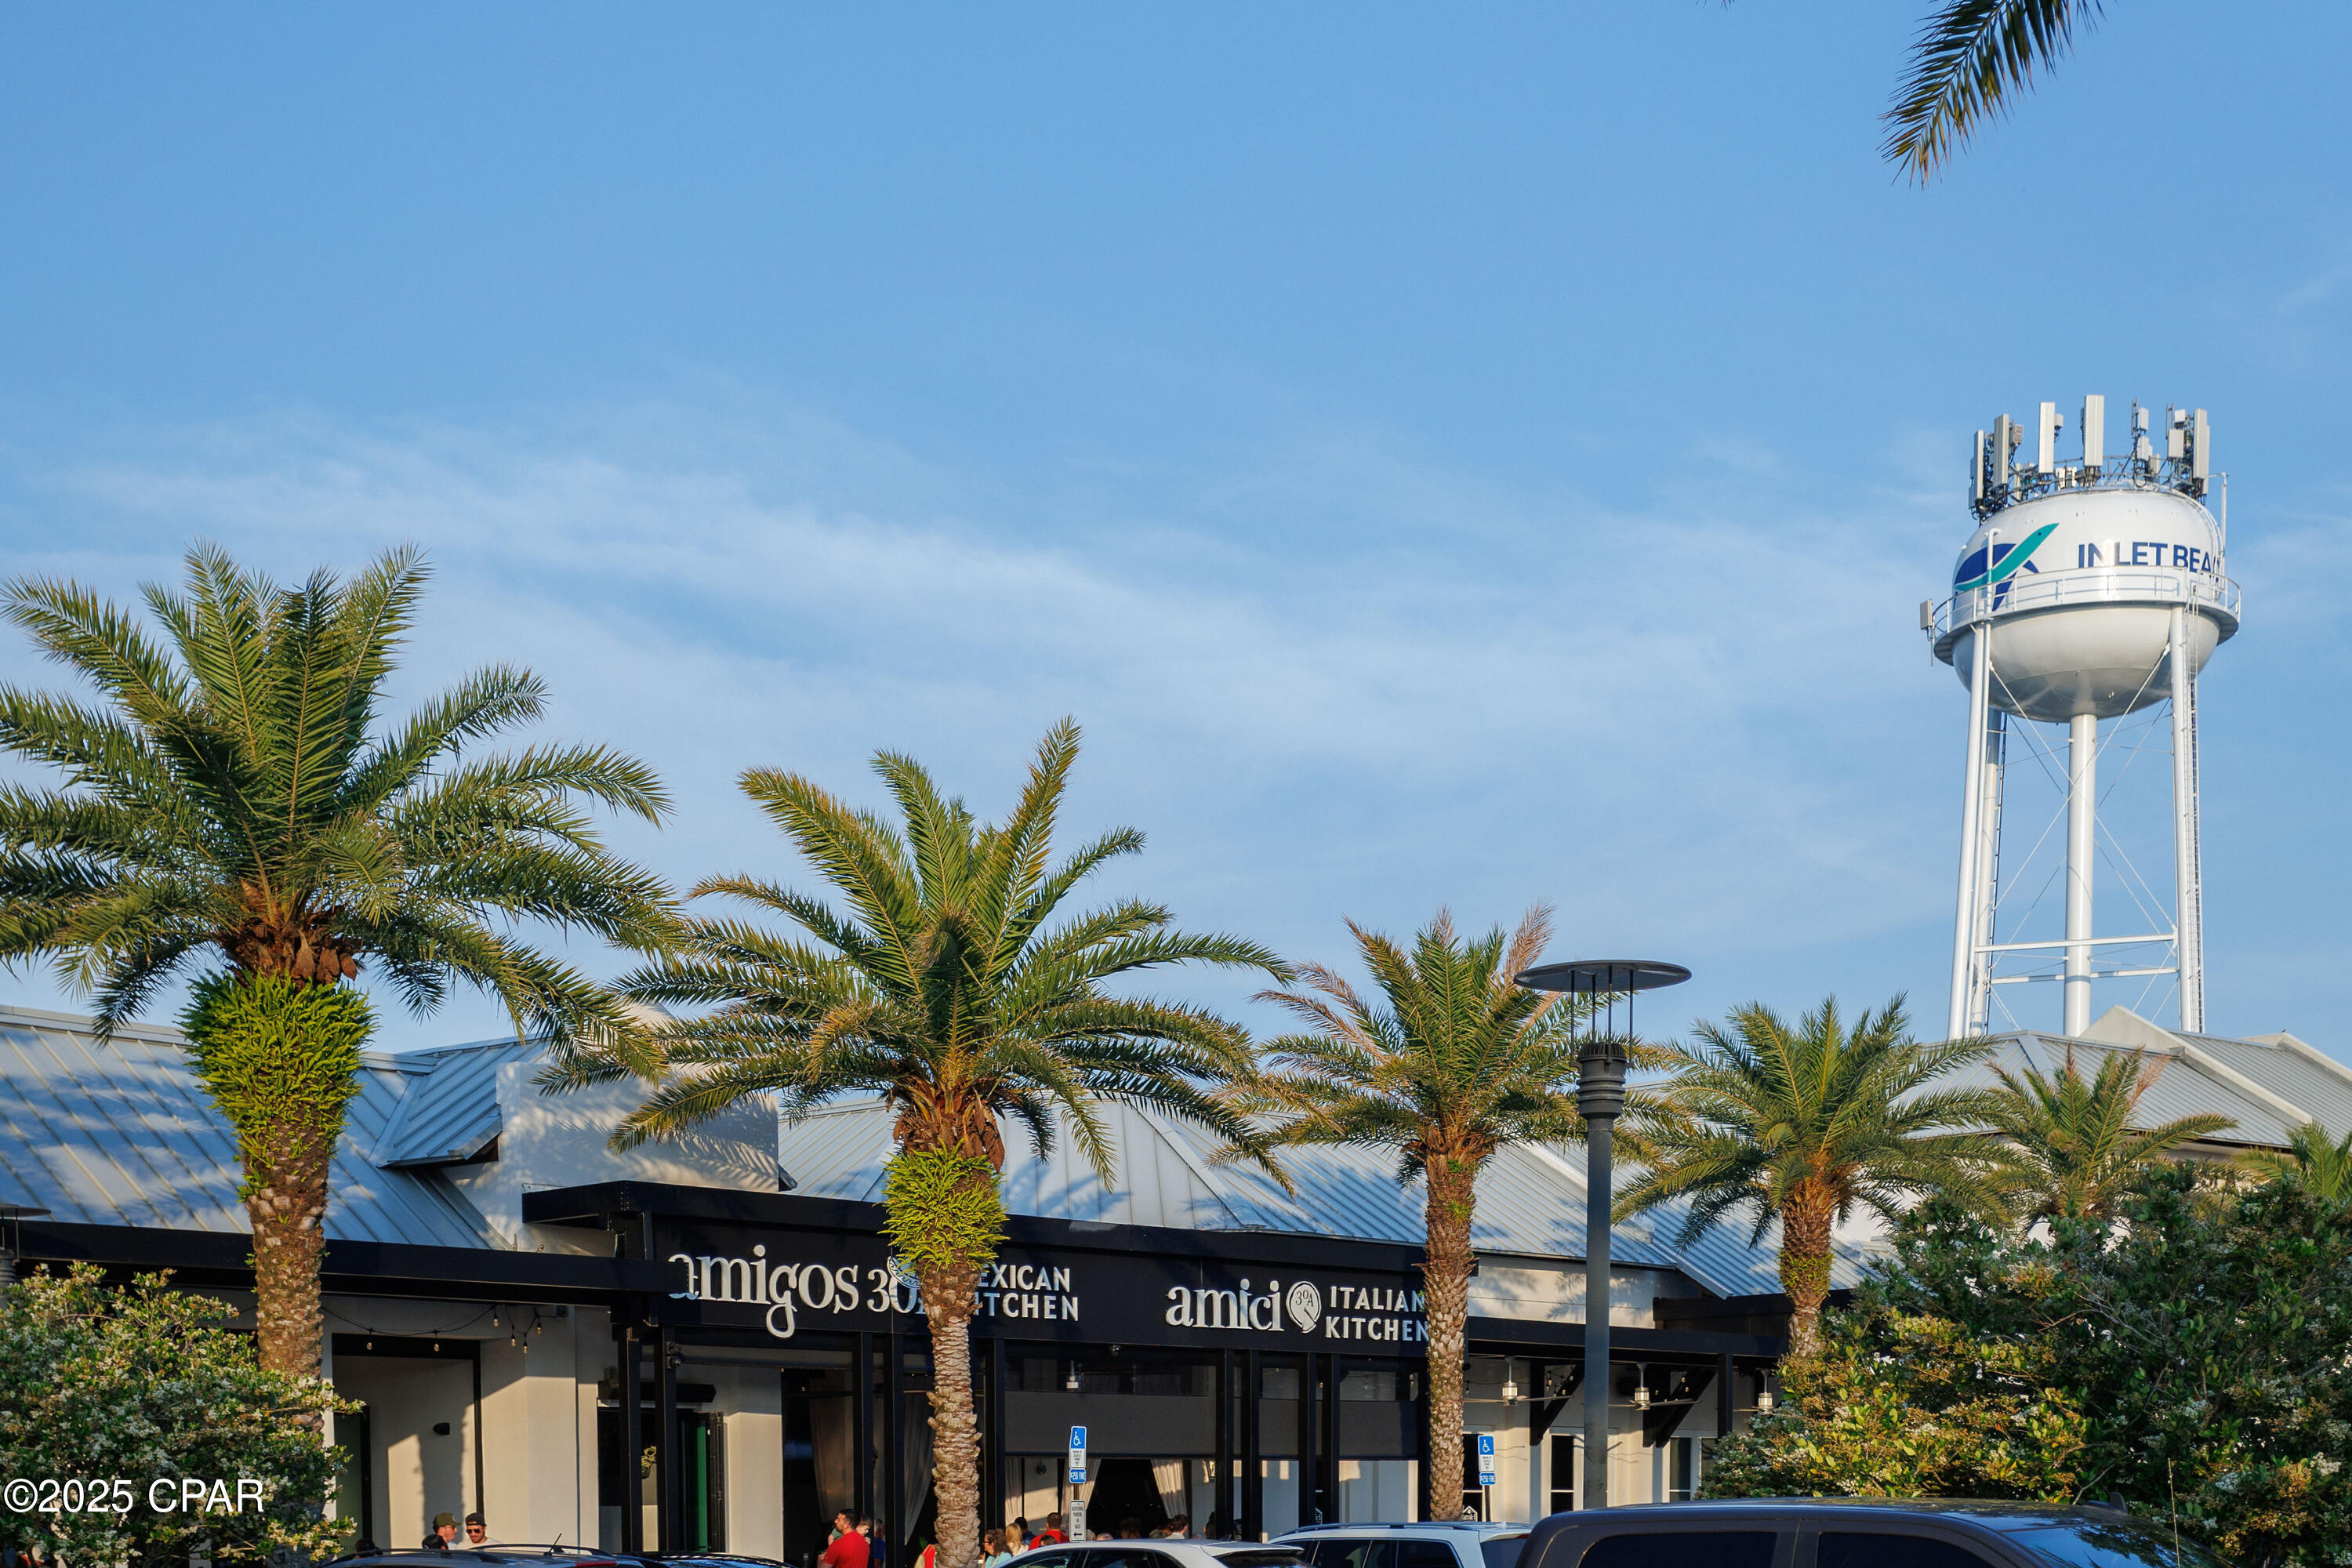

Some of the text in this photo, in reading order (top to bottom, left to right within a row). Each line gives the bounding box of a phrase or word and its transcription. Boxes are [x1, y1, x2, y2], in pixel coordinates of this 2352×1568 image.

[2078, 541, 2168, 568] INLET
[866, 1269, 927, 1314] 30
[978, 1264, 1070, 1293] EXICAN
[975, 1291, 1079, 1322] ITCHEN
[1166, 1278, 1285, 1331] amici
[1330, 1286, 1425, 1312] ITALIAN
[1325, 1316, 1429, 1342] KITCHEN
